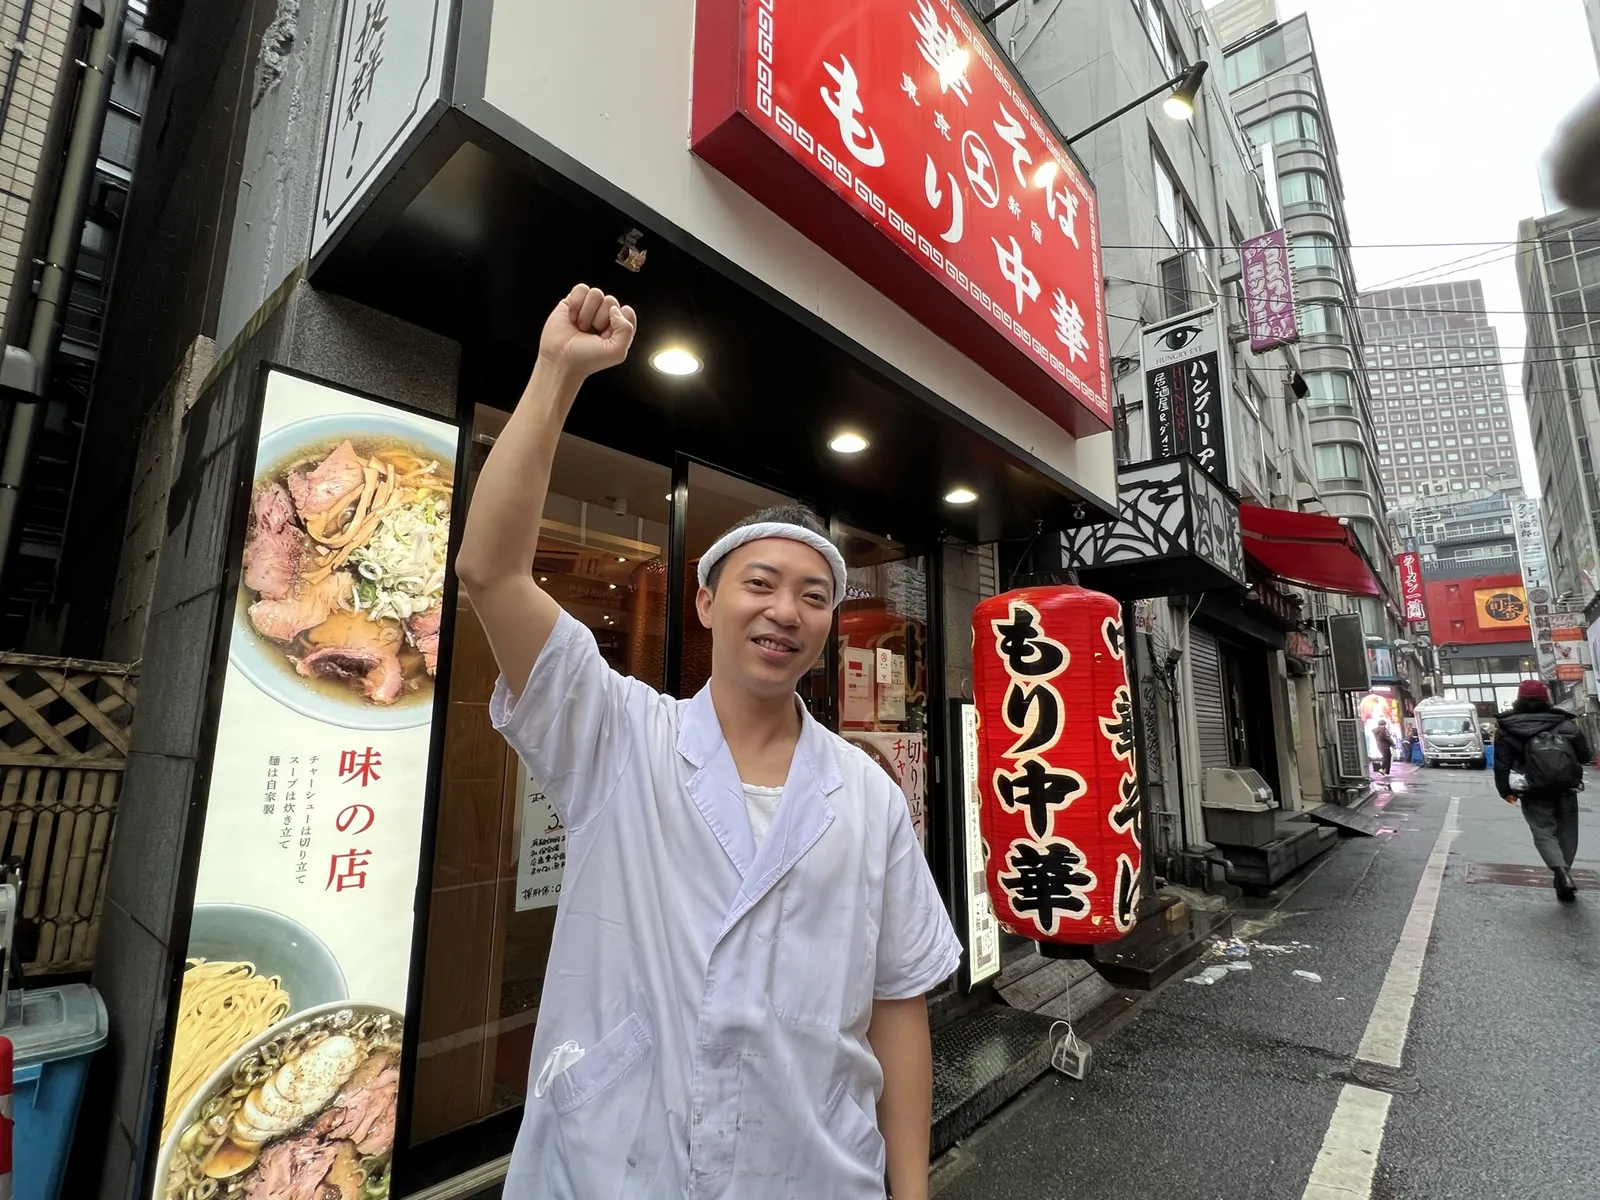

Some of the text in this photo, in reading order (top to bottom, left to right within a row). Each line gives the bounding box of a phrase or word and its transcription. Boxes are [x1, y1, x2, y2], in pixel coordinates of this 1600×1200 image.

[819, 53, 1090, 363] もり中華
[1156, 344, 1203, 365] HUNGRY EYE
[1172, 366, 1187, 441] HUNGRY
[278, 755, 300, 849] スープは炊き立て
[295, 755, 320, 884] チャーシューは切り立て
[325, 746, 382, 893] 味の店
[994, 605, 1094, 934] もり中華
